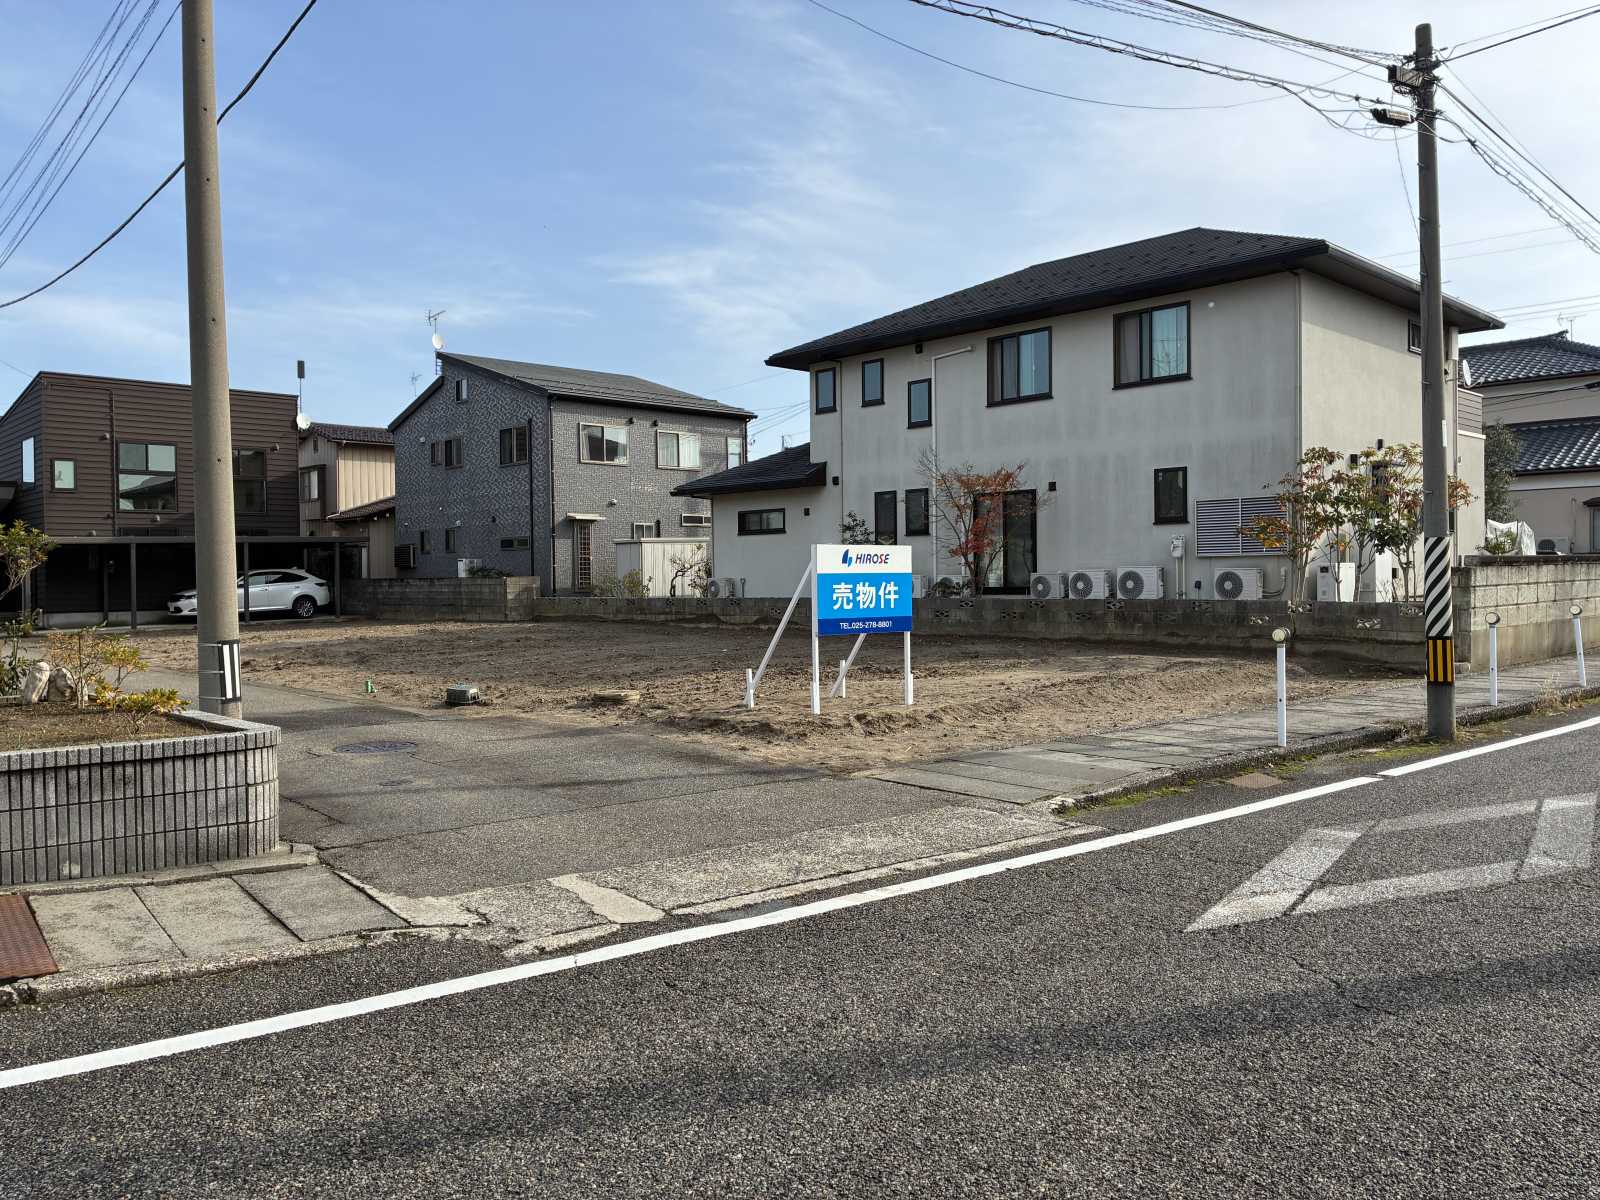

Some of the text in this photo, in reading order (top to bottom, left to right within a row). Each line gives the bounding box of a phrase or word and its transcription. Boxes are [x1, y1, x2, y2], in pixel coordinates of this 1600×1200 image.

[855, 553, 890, 564] HIROSE
[832, 581, 899, 610] 売物件
